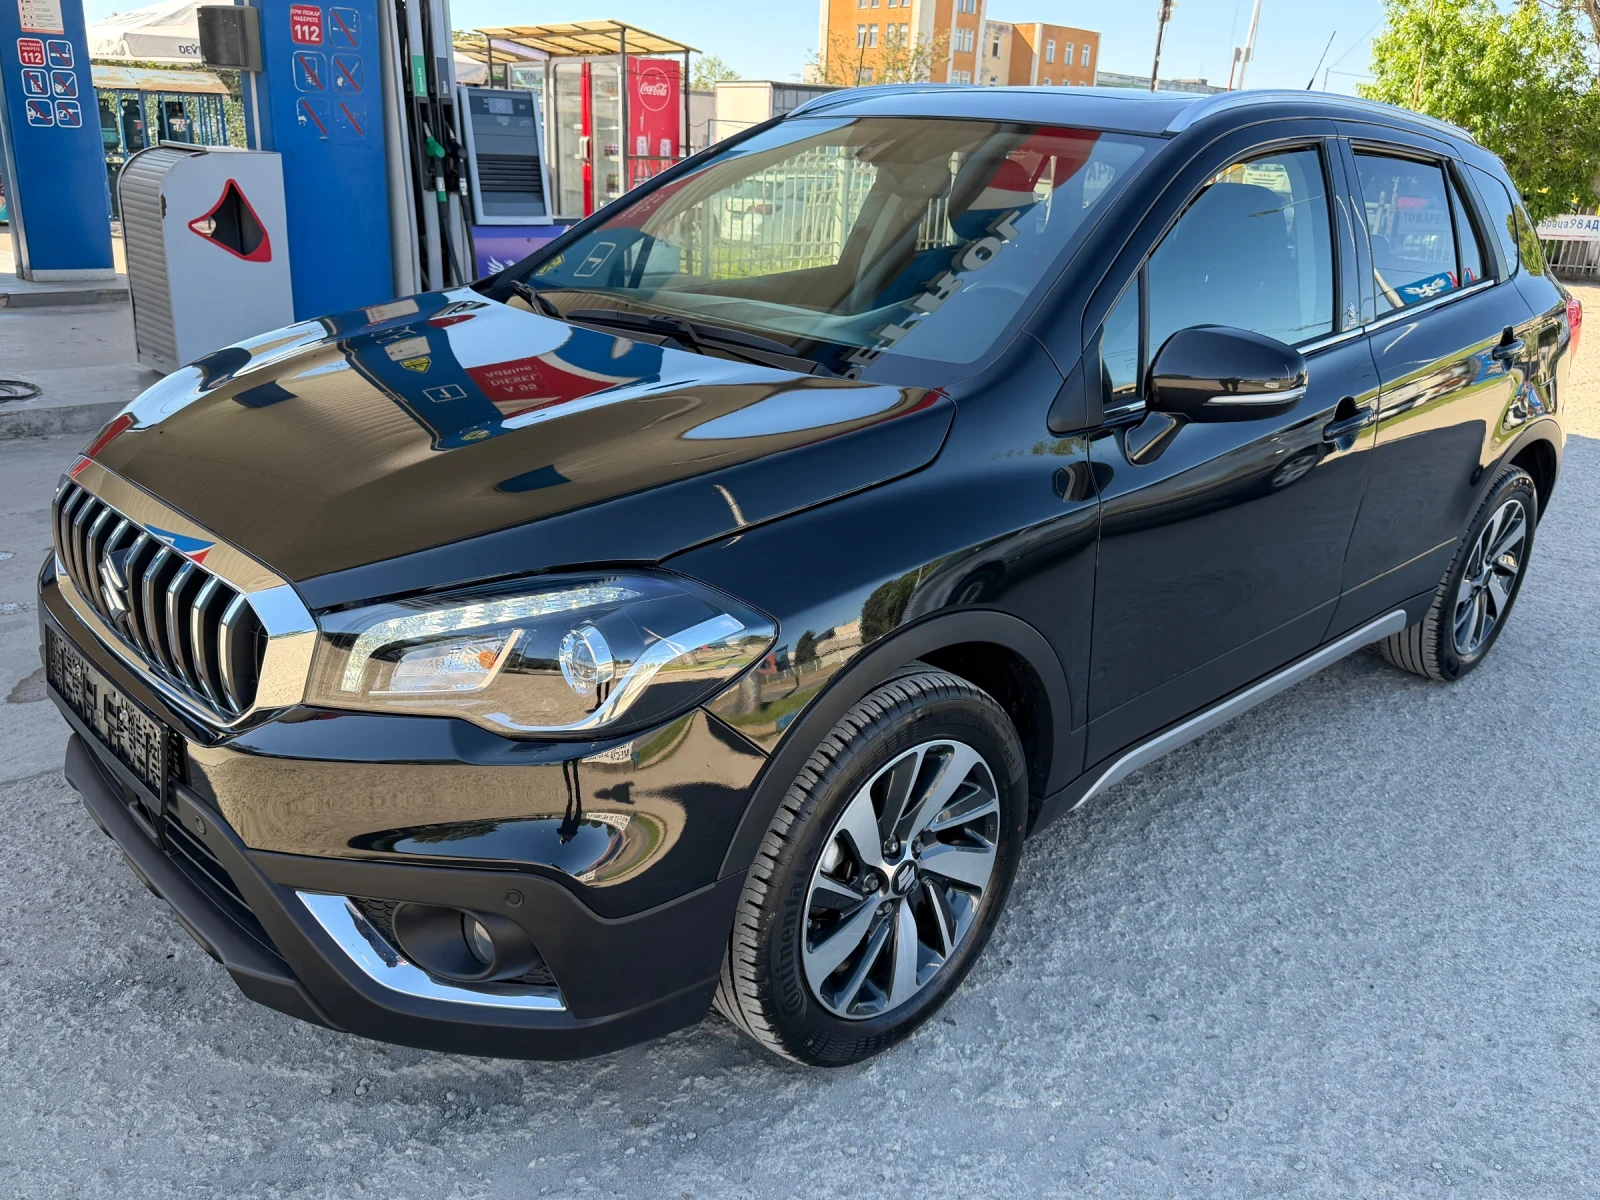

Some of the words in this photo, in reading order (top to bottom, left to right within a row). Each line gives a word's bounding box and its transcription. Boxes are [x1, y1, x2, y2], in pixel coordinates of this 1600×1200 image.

[294, 24, 320, 42] 112
[178, 44, 201, 54] DEV
[22, 52, 42, 63] 112
[775, 868, 807, 1018] Continental
